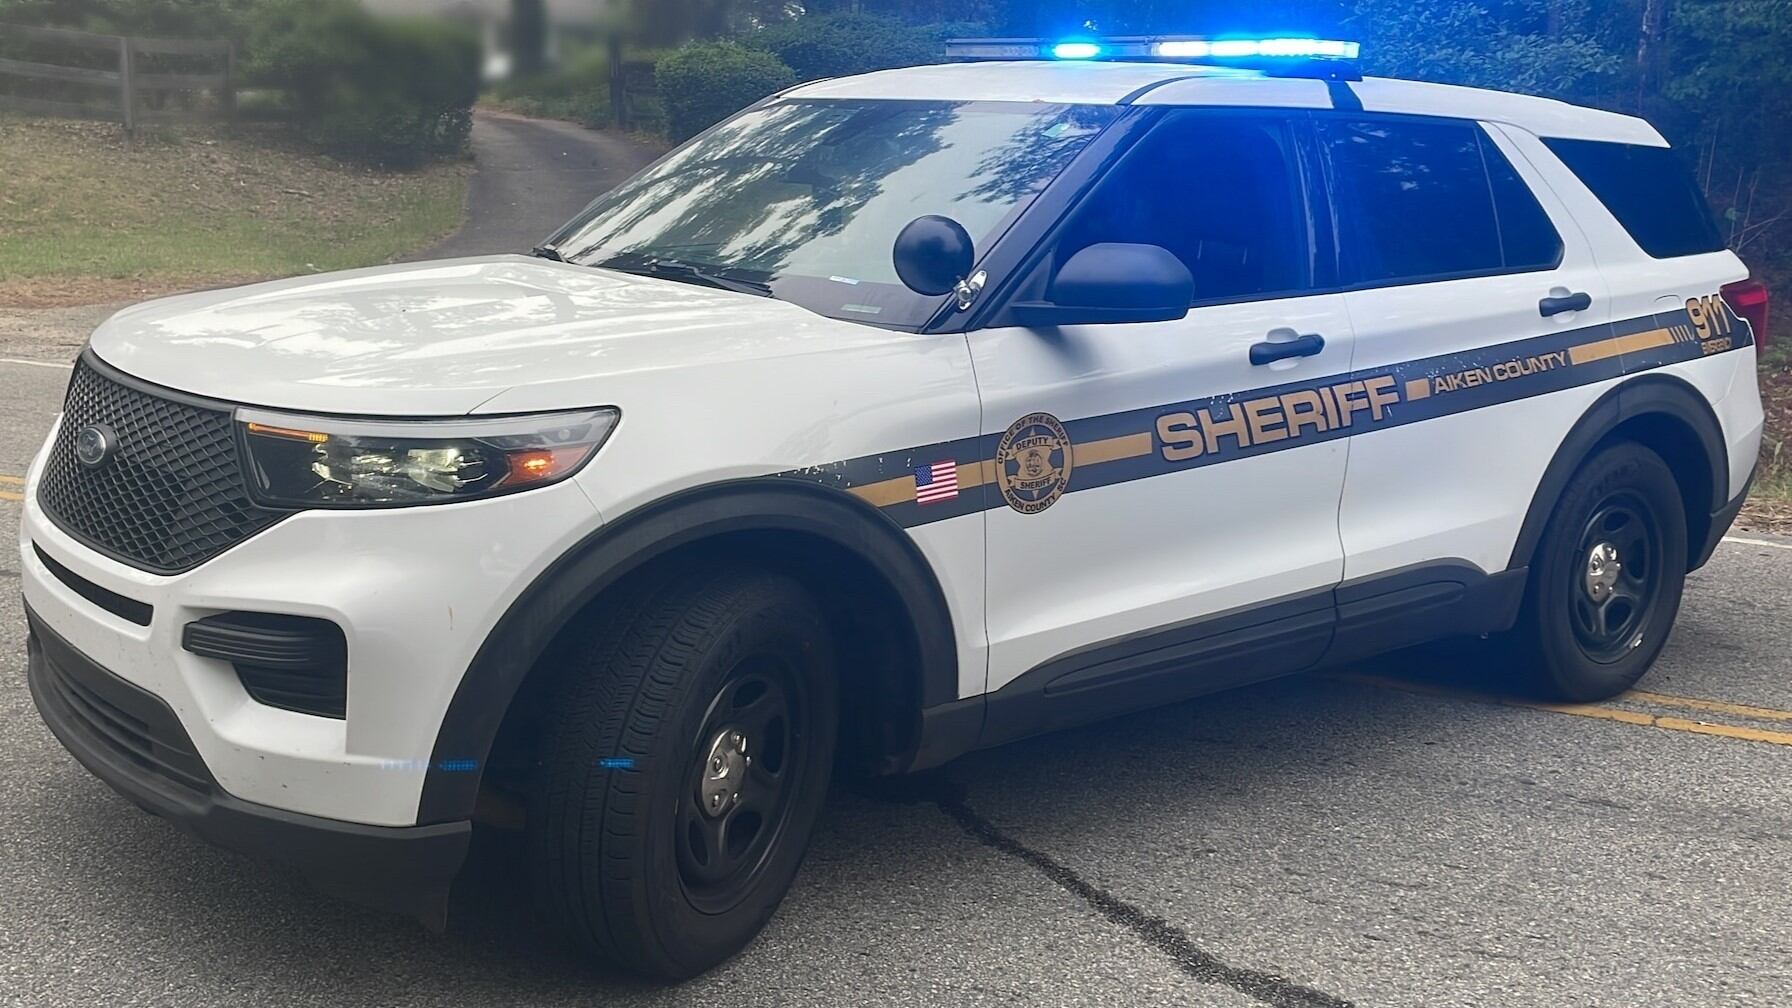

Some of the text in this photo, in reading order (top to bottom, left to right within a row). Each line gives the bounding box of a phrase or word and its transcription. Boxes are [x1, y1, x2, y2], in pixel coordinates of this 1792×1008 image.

[1686, 294, 1731, 339] 911
[1157, 351, 1567, 462] SHERIFF AIKEN COUNTY
[997, 415, 1069, 465] OFFICE OF THE SHERIFF
[1015, 436, 1049, 450] DEPUTY
[1004, 489, 1025, 511] AIKEN
[1025, 495, 1056, 512] COUNTY
[1020, 477, 1052, 490] SHERIFF
